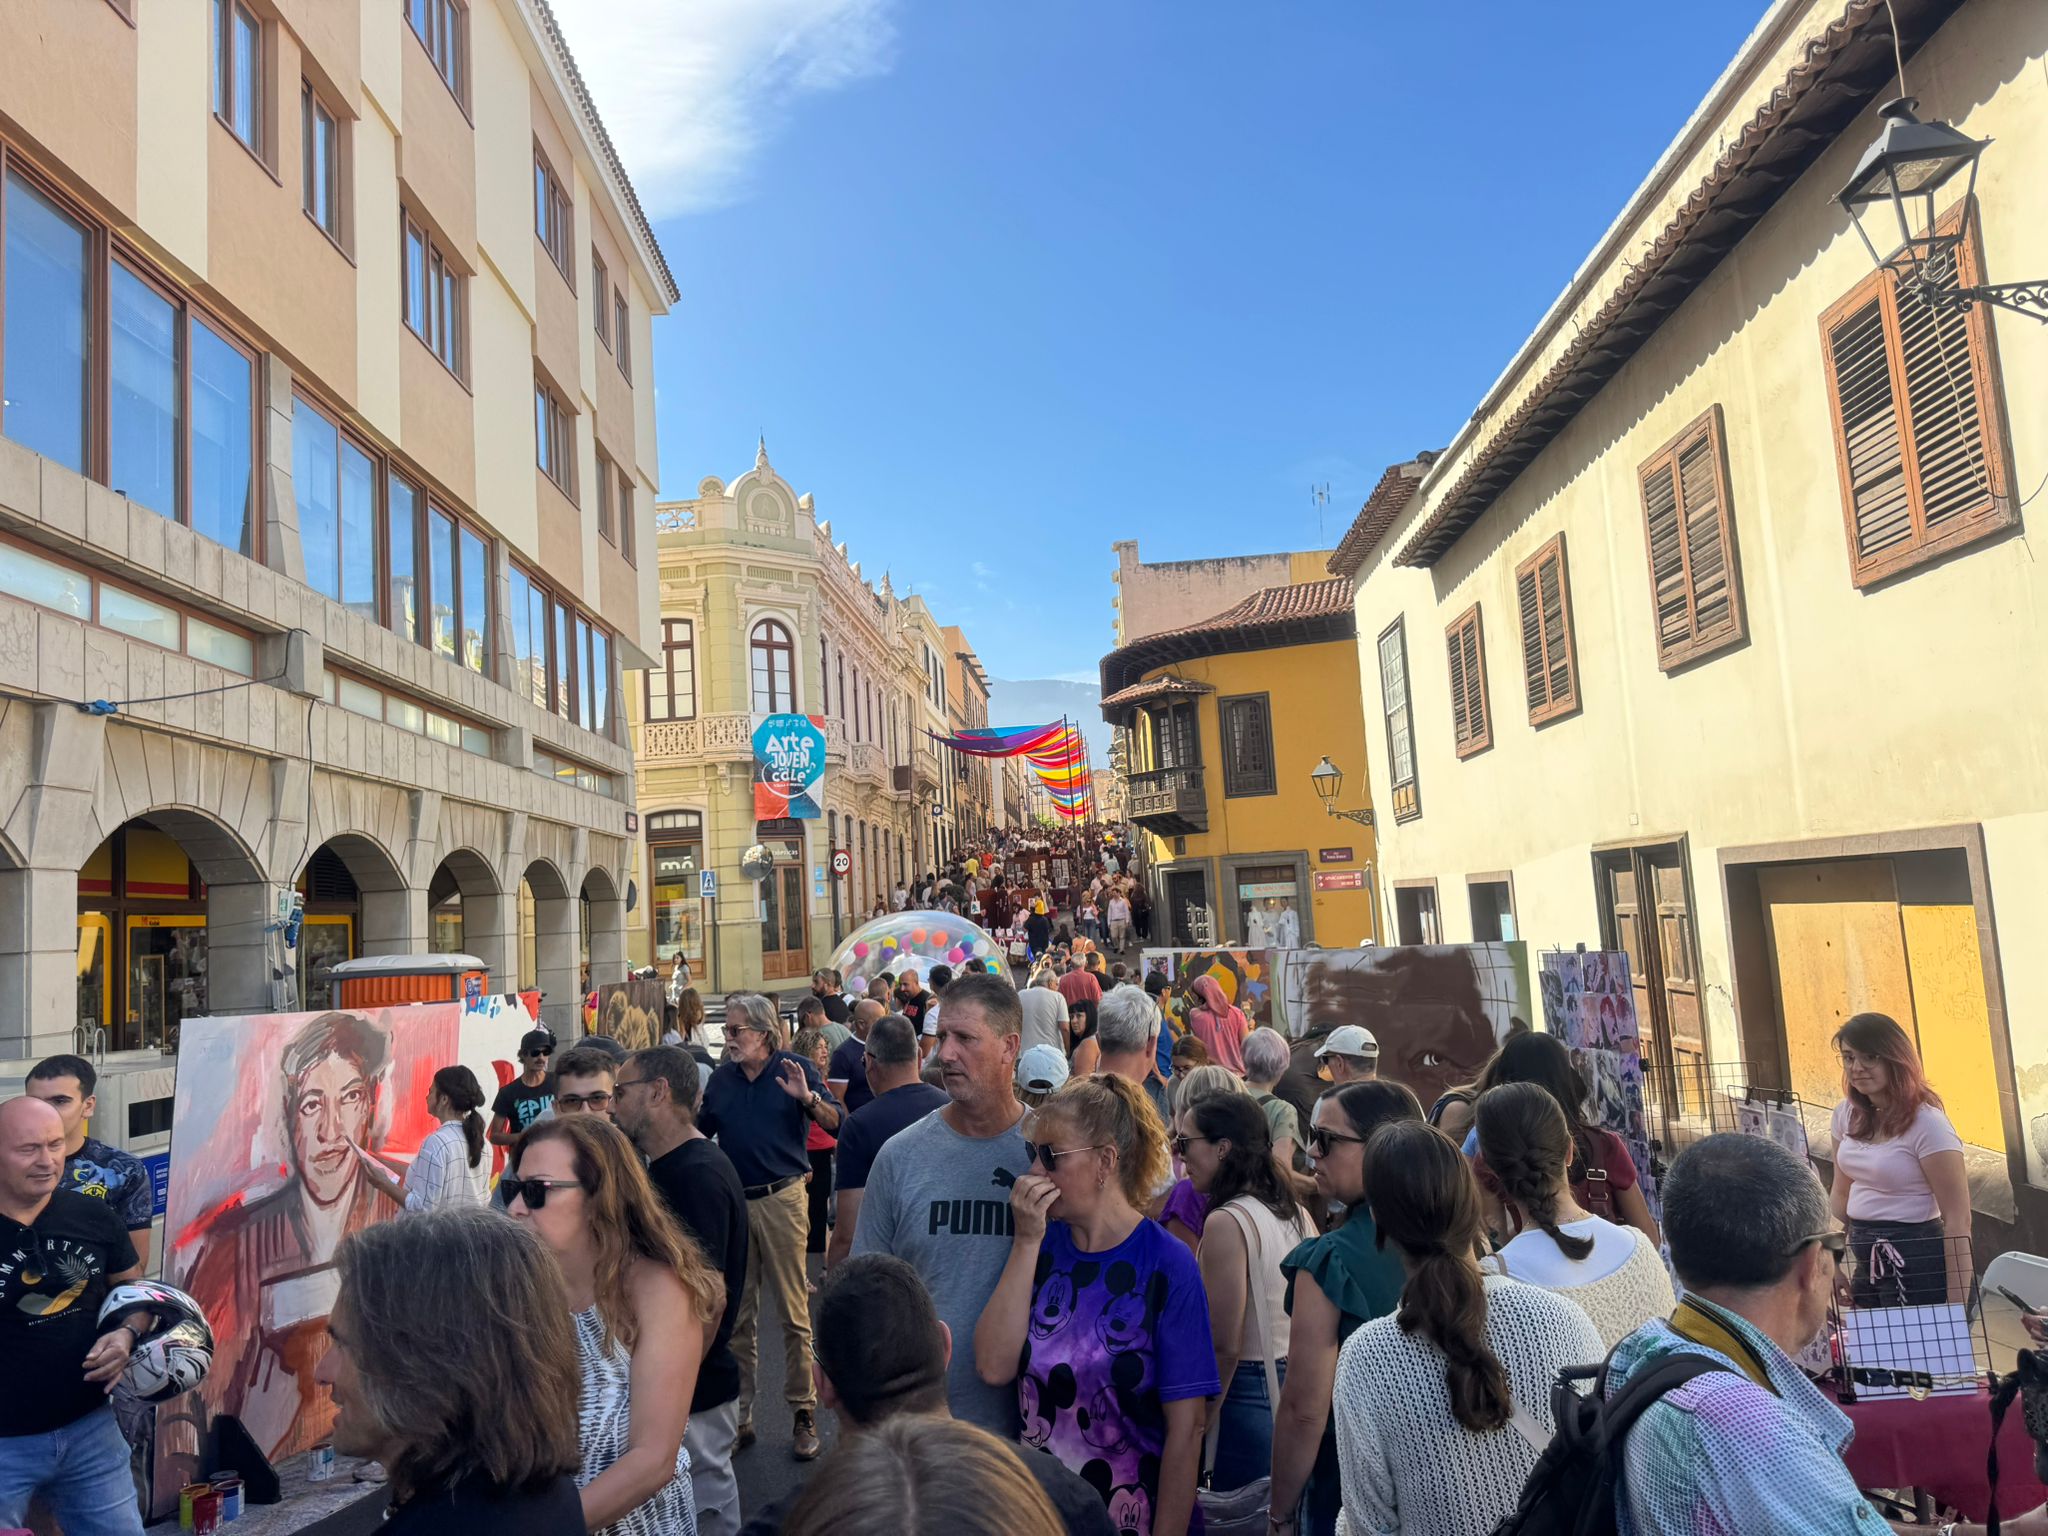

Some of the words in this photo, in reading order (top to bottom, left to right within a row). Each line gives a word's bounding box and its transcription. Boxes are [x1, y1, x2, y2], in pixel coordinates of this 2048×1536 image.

[765, 732, 814, 754] Arte
[771, 751, 810, 769] JOVEN
[836, 858, 848, 866] 20
